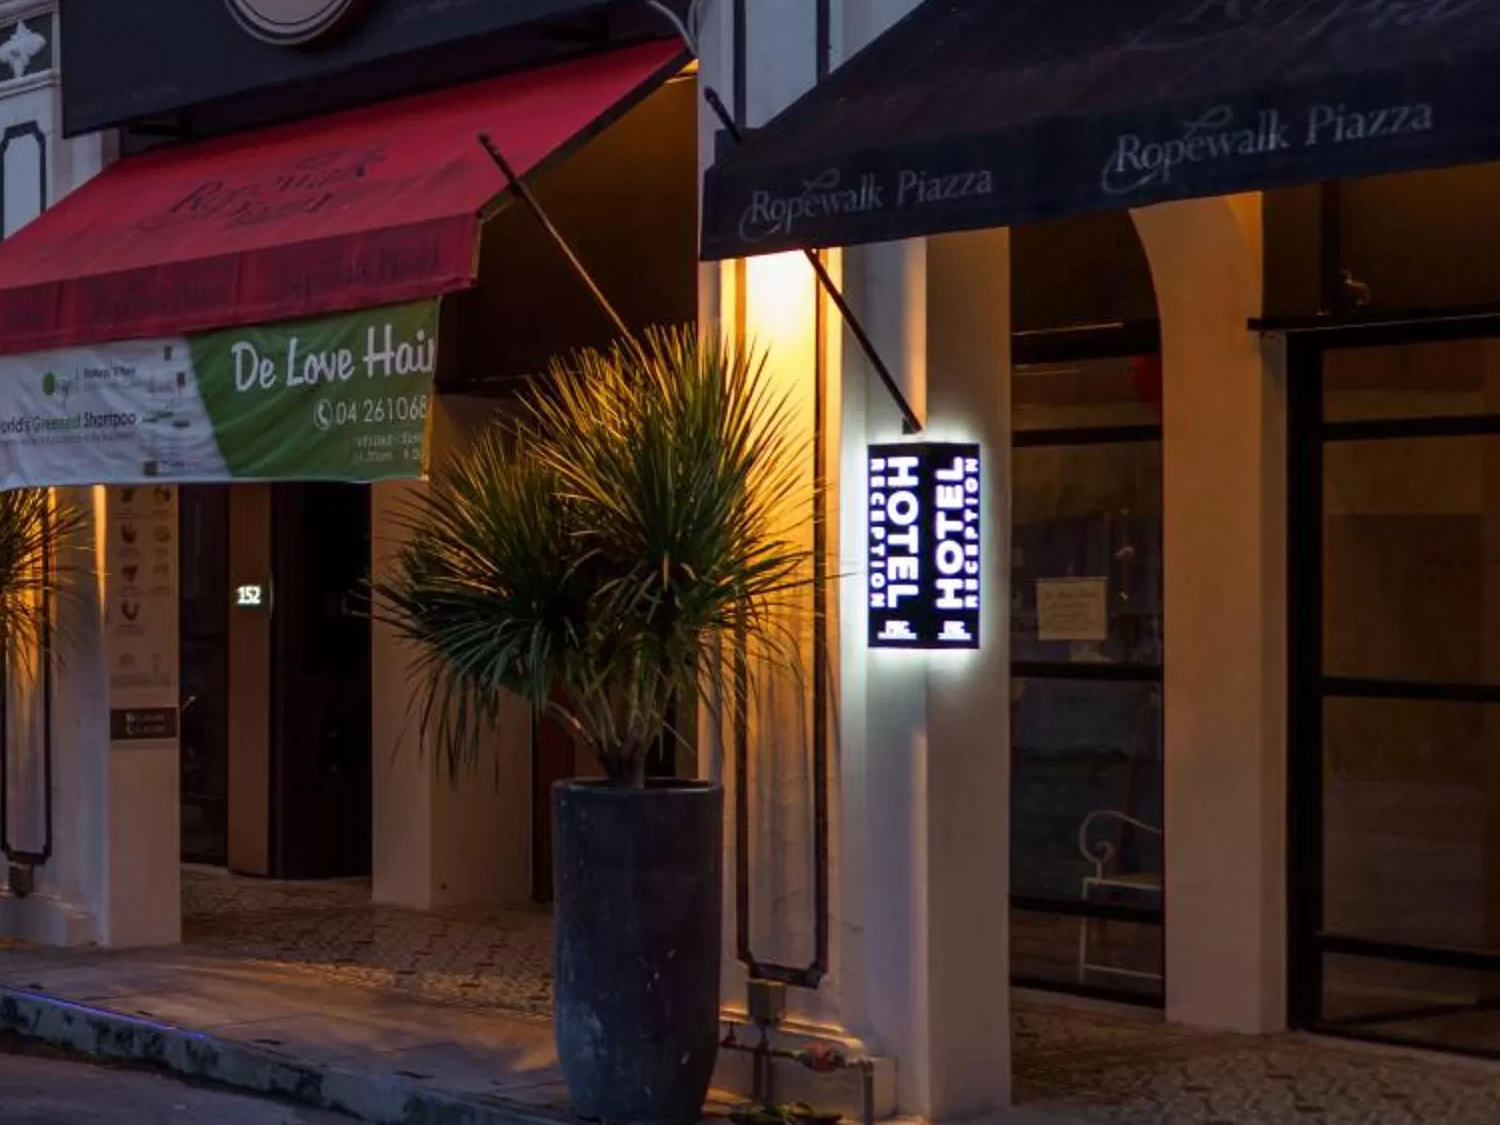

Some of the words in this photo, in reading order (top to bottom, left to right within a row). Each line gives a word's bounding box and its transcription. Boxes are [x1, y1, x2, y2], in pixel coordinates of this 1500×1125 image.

[1102, 103, 1290, 195] Ropewalk
[1305, 101, 1434, 146] Piazza
[740, 164, 884, 243] Ropewalk
[897, 166, 993, 208] Piazza
[231, 340, 277, 393] De
[286, 335, 356, 387] Love
[83, 410, 137, 431] Shampoo
[335, 400, 358, 426] 04
[870, 458, 886, 609] RECEPTION
[887, 456, 919, 608] HOTEL
[936, 456, 964, 609] HOTEL
[965, 457, 978, 609] RECEPTION
[236, 585, 261, 604] 152
